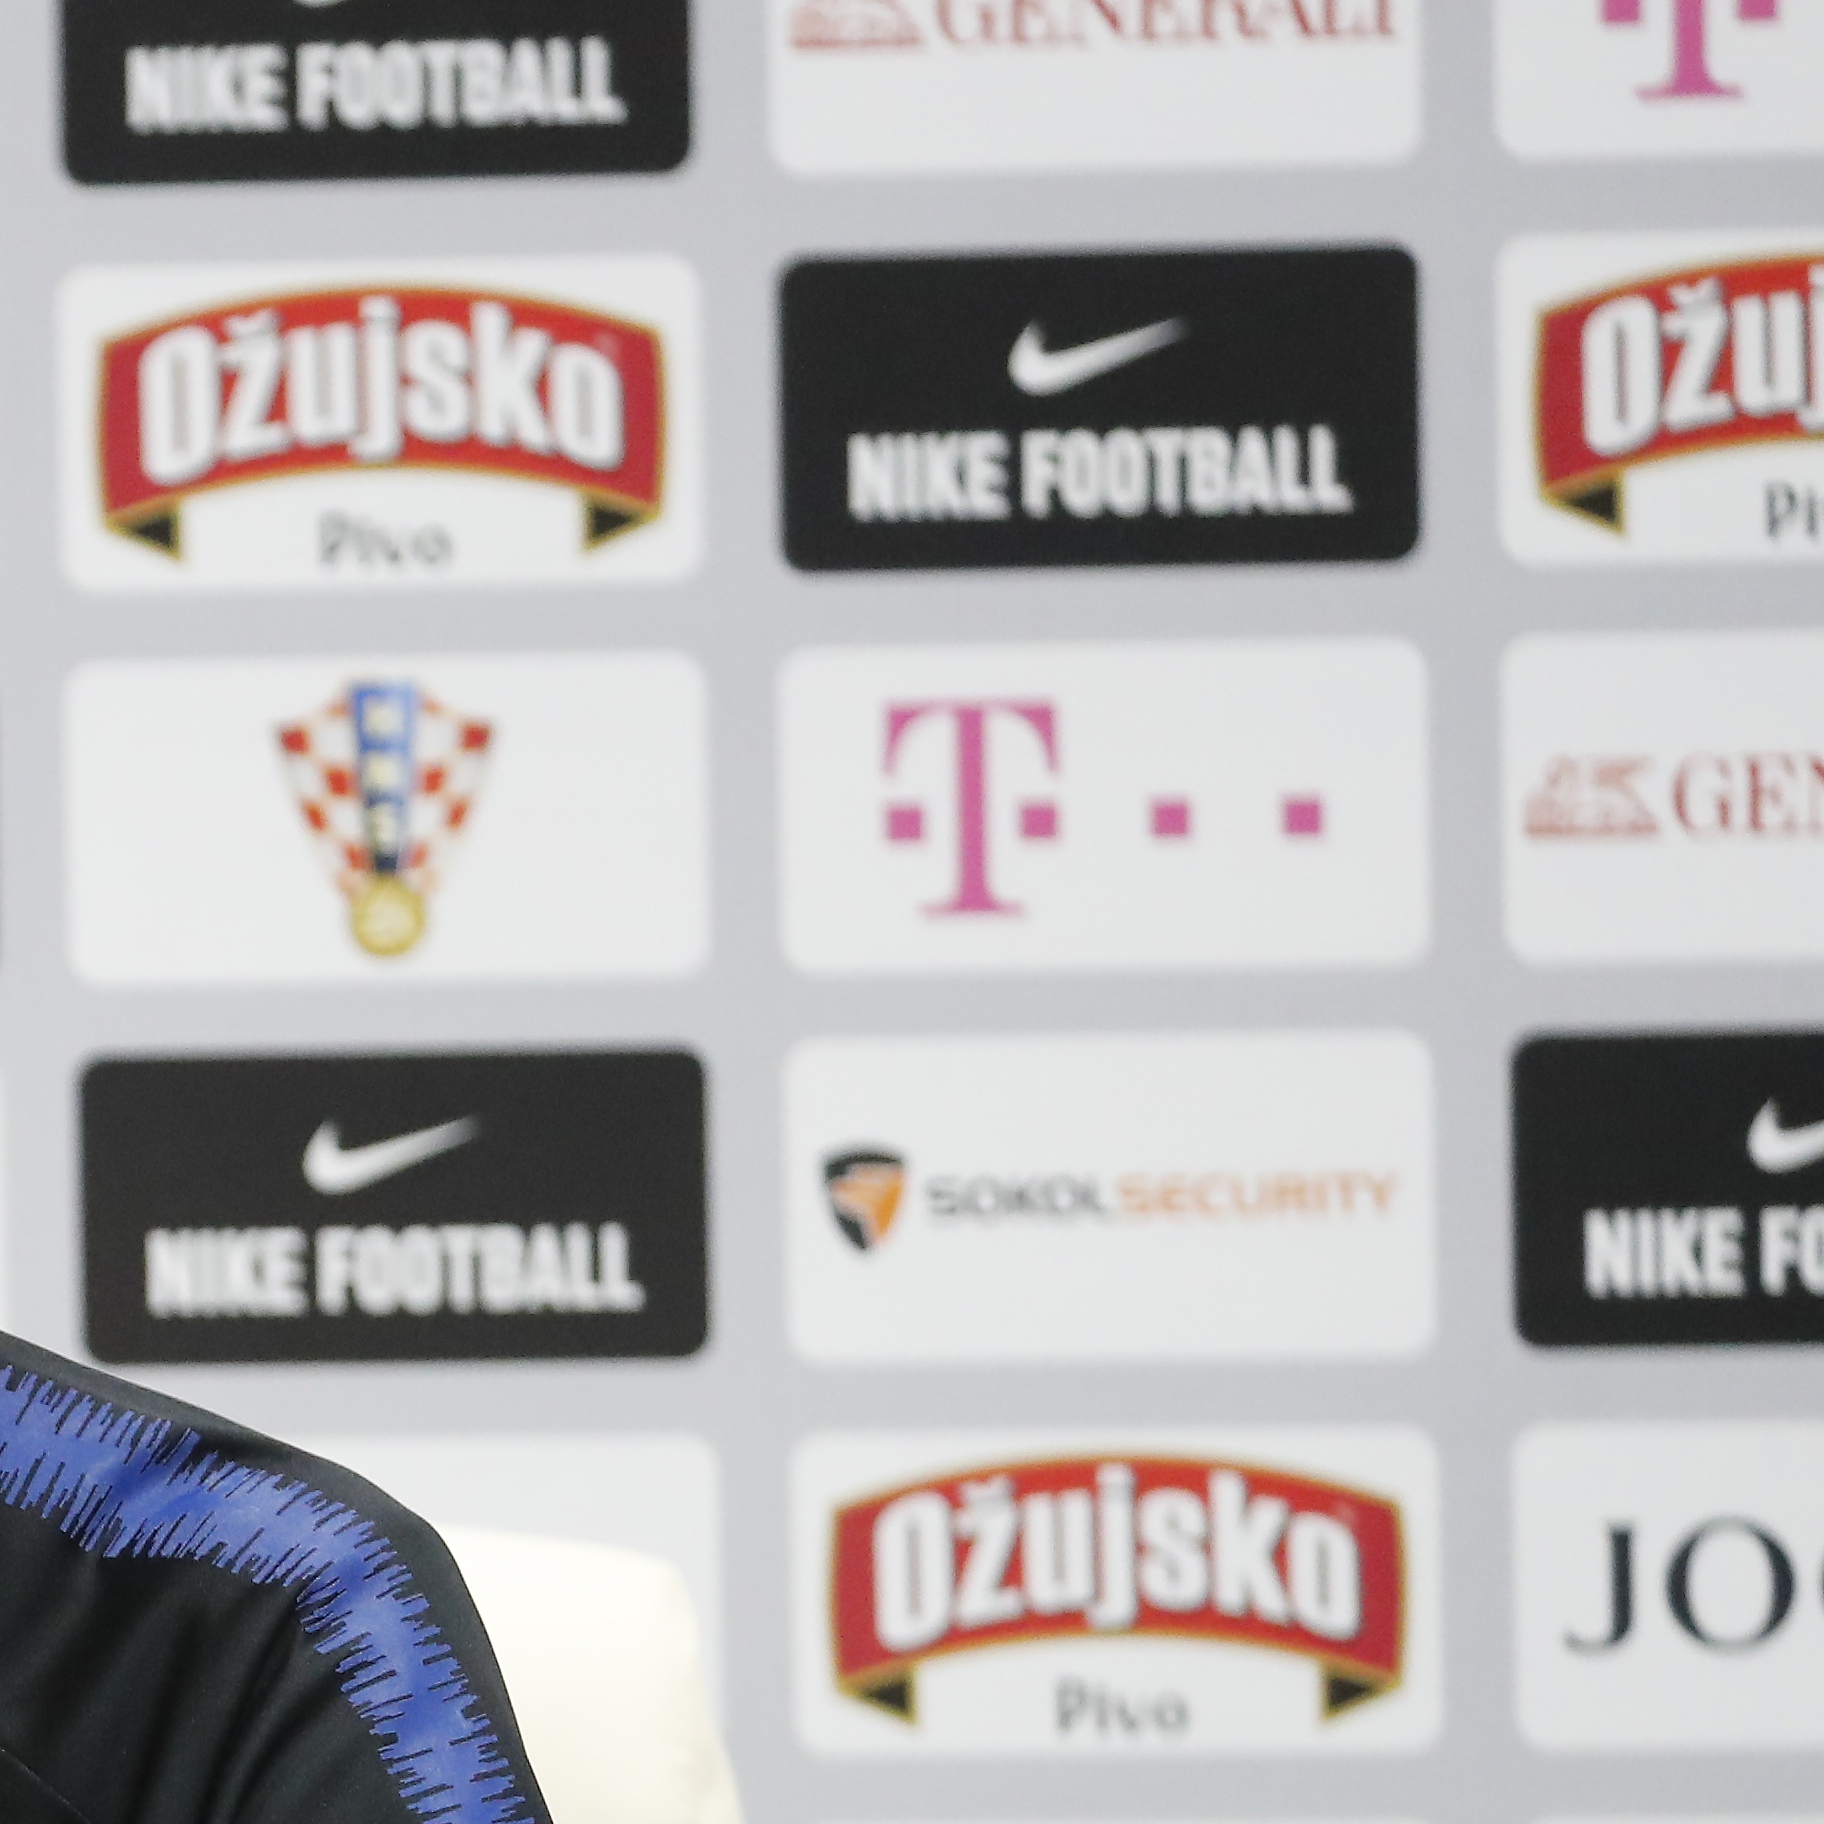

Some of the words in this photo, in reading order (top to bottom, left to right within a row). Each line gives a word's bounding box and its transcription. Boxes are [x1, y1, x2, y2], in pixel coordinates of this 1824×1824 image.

[126, 38, 287, 132] NIKE
[297, 38, 627, 132] FOOTBALL
[138, 295, 625, 487] Ožujsko
[848, 426, 1009, 520] NIKE
[1021, 426, 1353, 520] FOOTBALL
[146, 1224, 307, 1317] NIKE
[316, 1224, 645, 1317] FOOTBALL
[1585, 1207, 1745, 1297] NIKE
[872, 1463, 1365, 1656] Ožujsko
